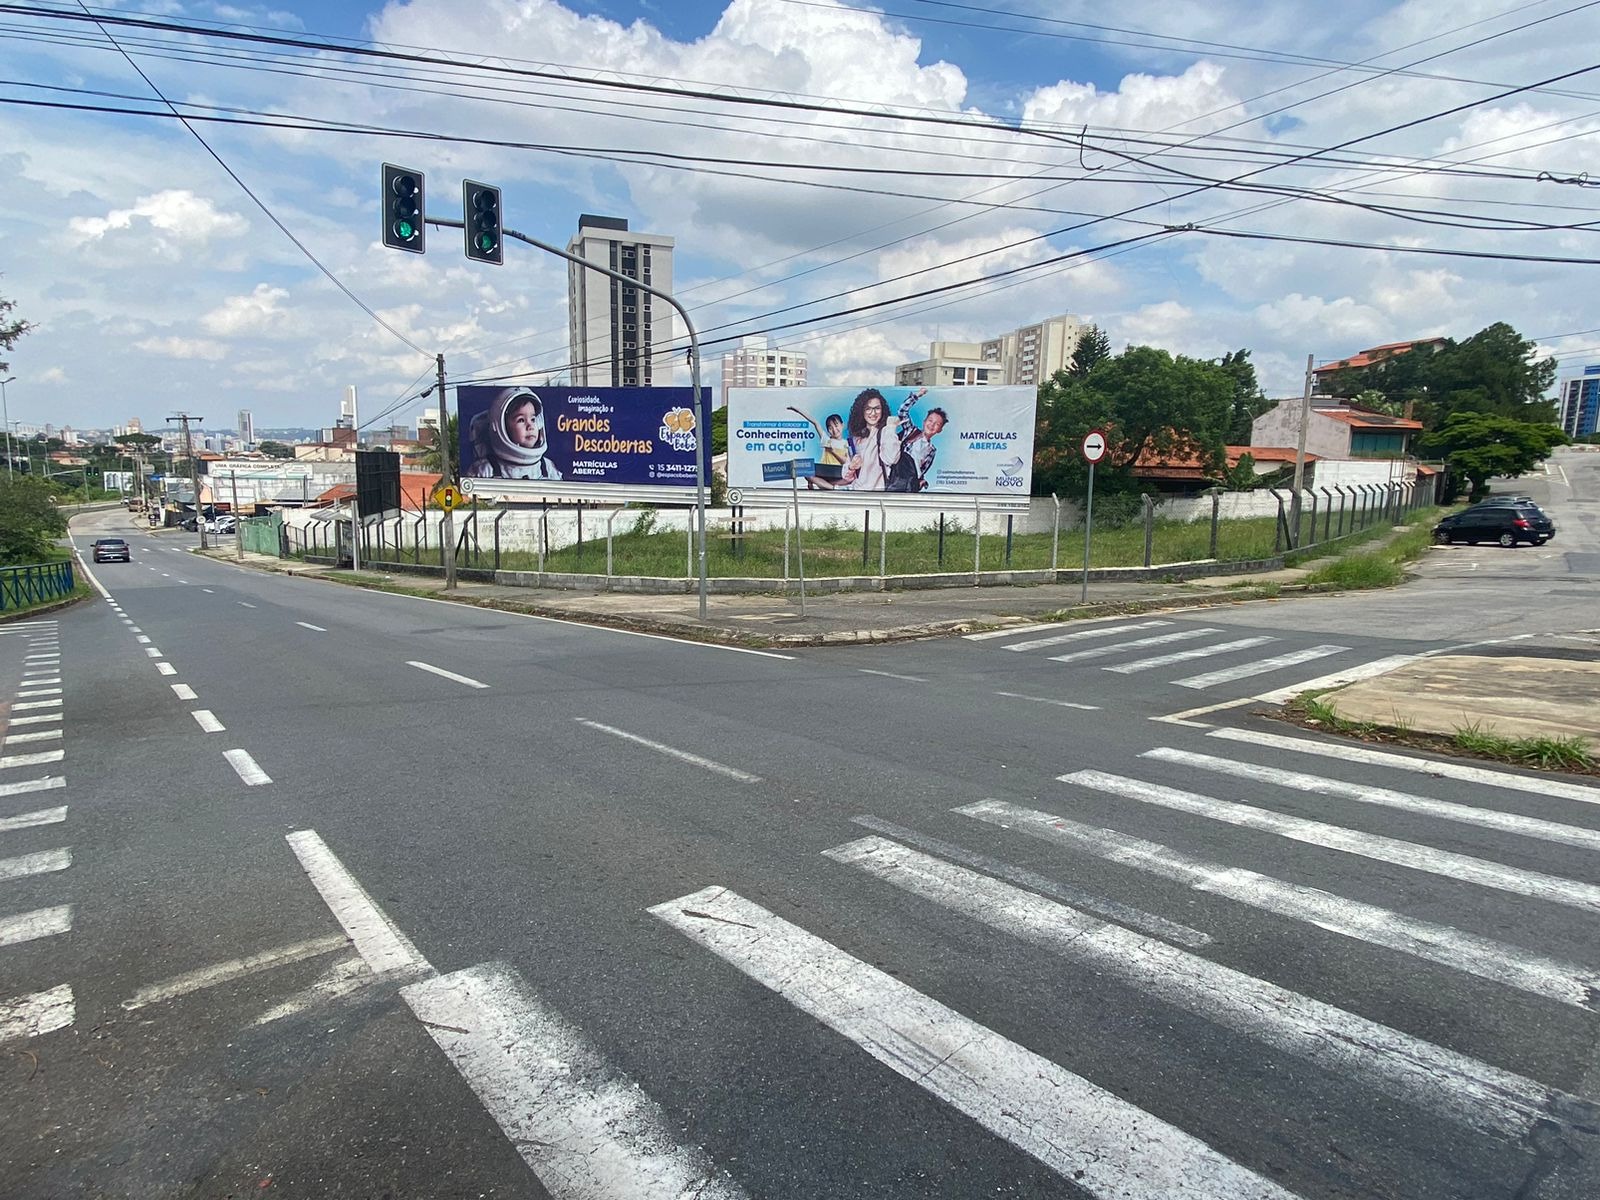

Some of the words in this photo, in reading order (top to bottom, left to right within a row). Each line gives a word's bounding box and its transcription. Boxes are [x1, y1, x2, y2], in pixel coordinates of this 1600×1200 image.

[557, 414, 610, 432] Grandes
[736, 429, 815, 439] Conhecimento
[960, 430, 1017, 440] MATRÍCULAS
[575, 434, 653, 454] Descobertas
[746, 442, 764, 451] em
[768, 441, 806, 454] ação!
[572, 460, 618, 468] MATRÍCULAS
